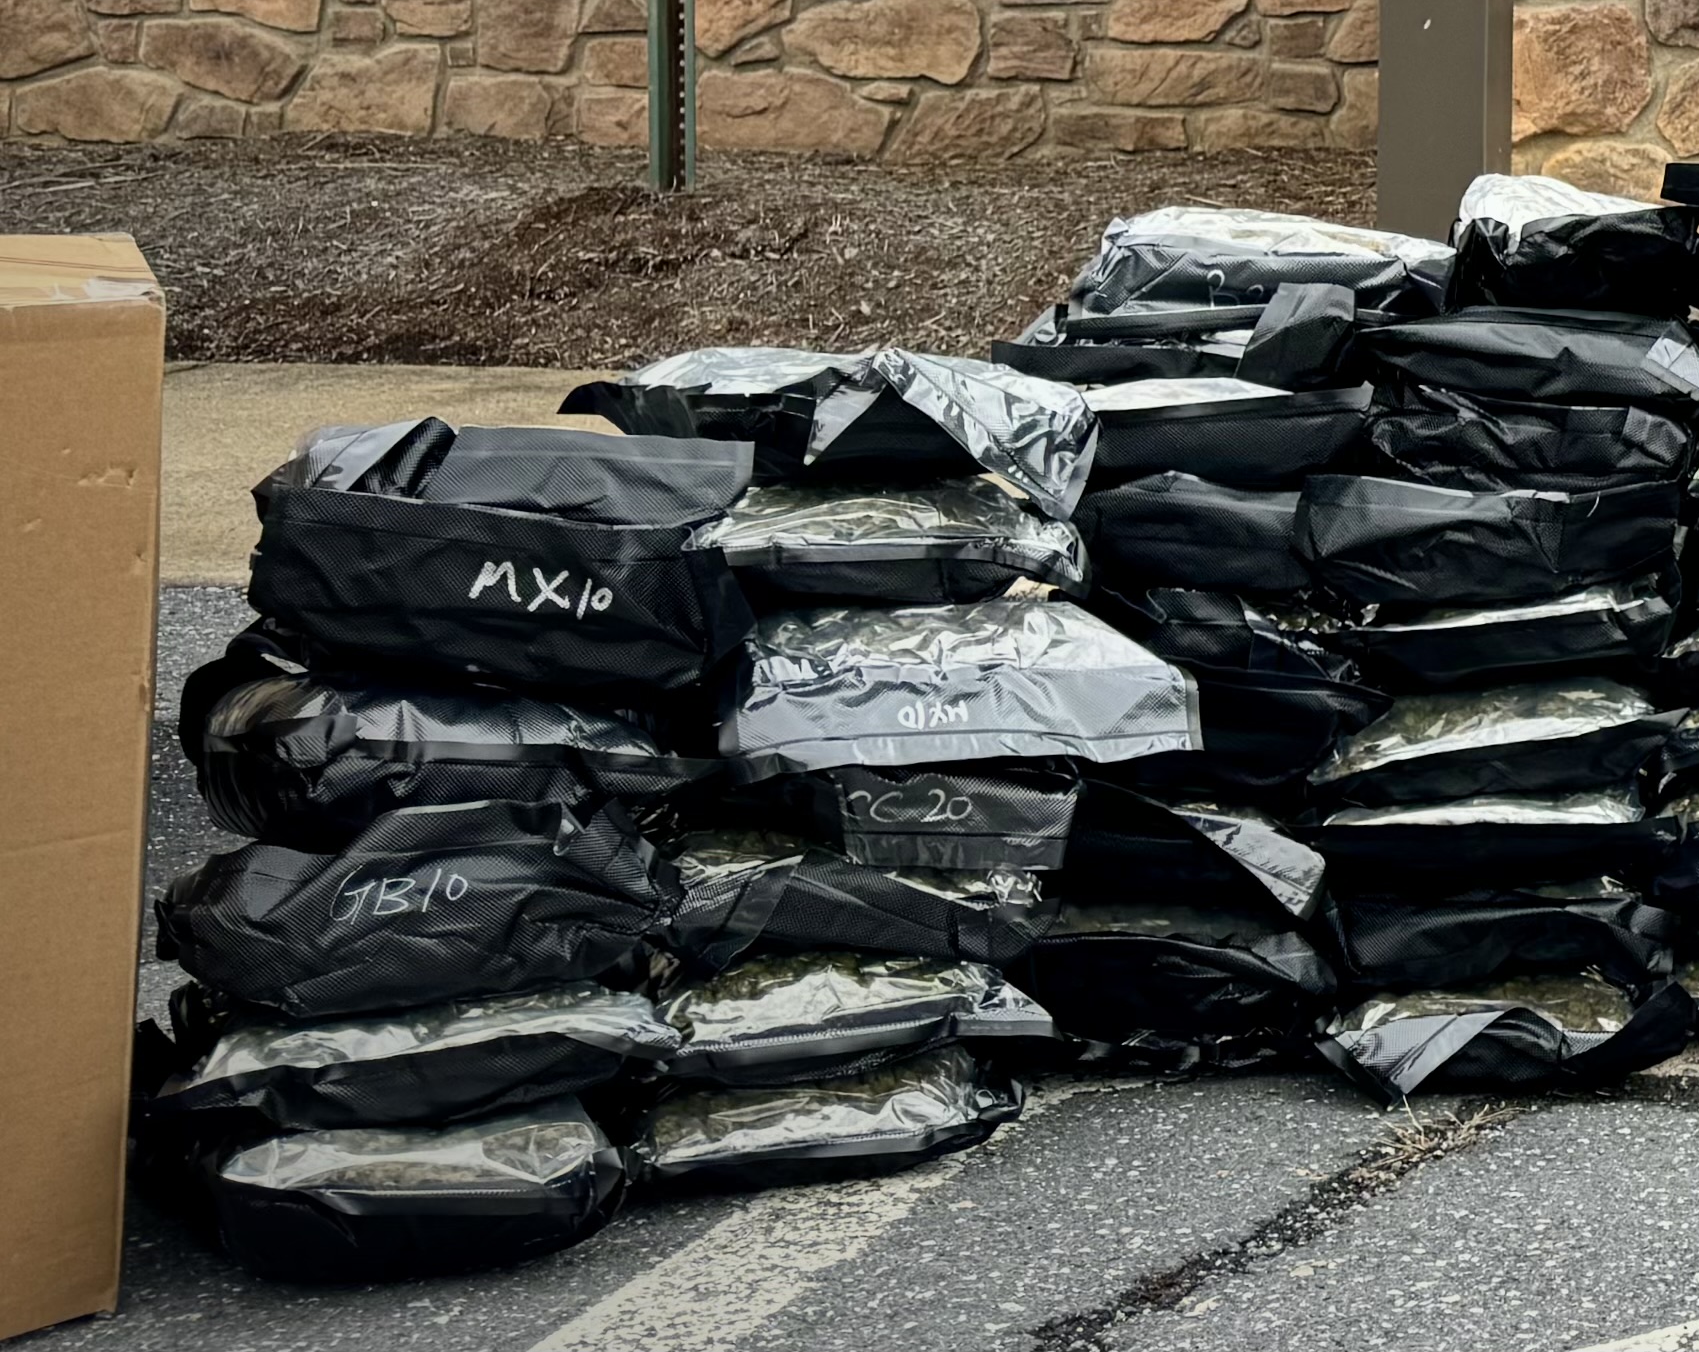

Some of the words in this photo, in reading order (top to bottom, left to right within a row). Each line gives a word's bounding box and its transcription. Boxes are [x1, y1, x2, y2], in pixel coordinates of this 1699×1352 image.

[468, 561, 614, 619] MX10
[920, 788, 974, 824] 20
[329, 867, 468, 926] GB10
